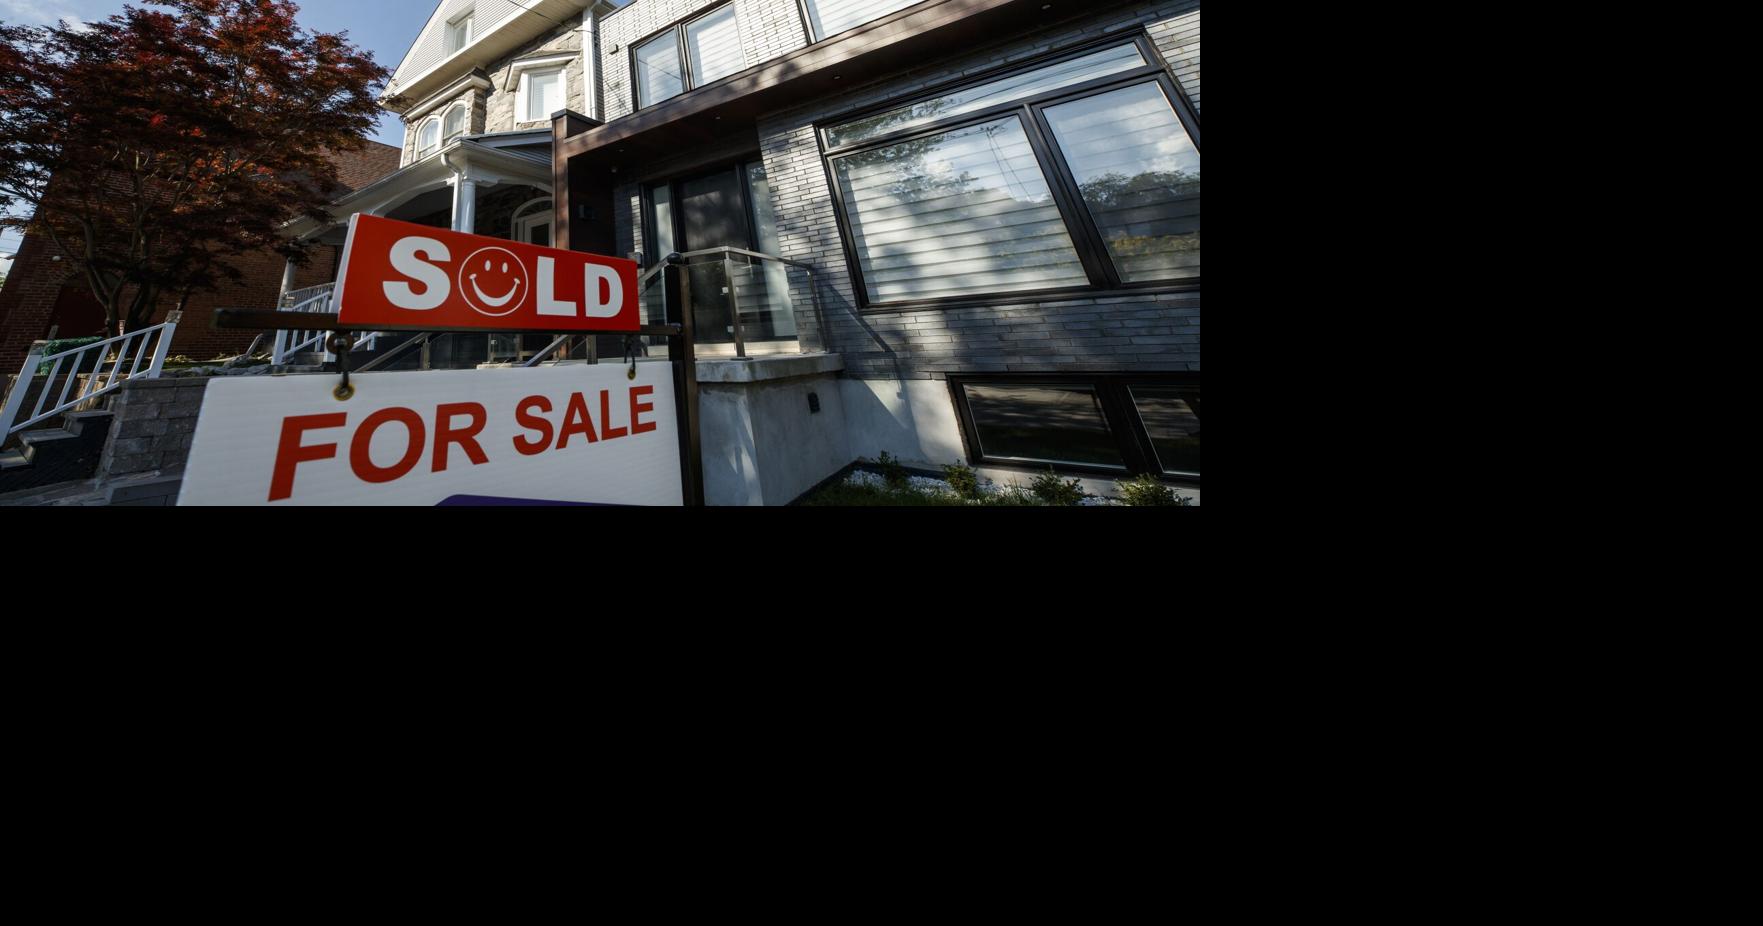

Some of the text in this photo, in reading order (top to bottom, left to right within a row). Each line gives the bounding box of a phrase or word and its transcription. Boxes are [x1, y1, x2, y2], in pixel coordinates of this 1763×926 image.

[383, 237, 624, 318] SOLD
[268, 385, 657, 501] FOR SALE
